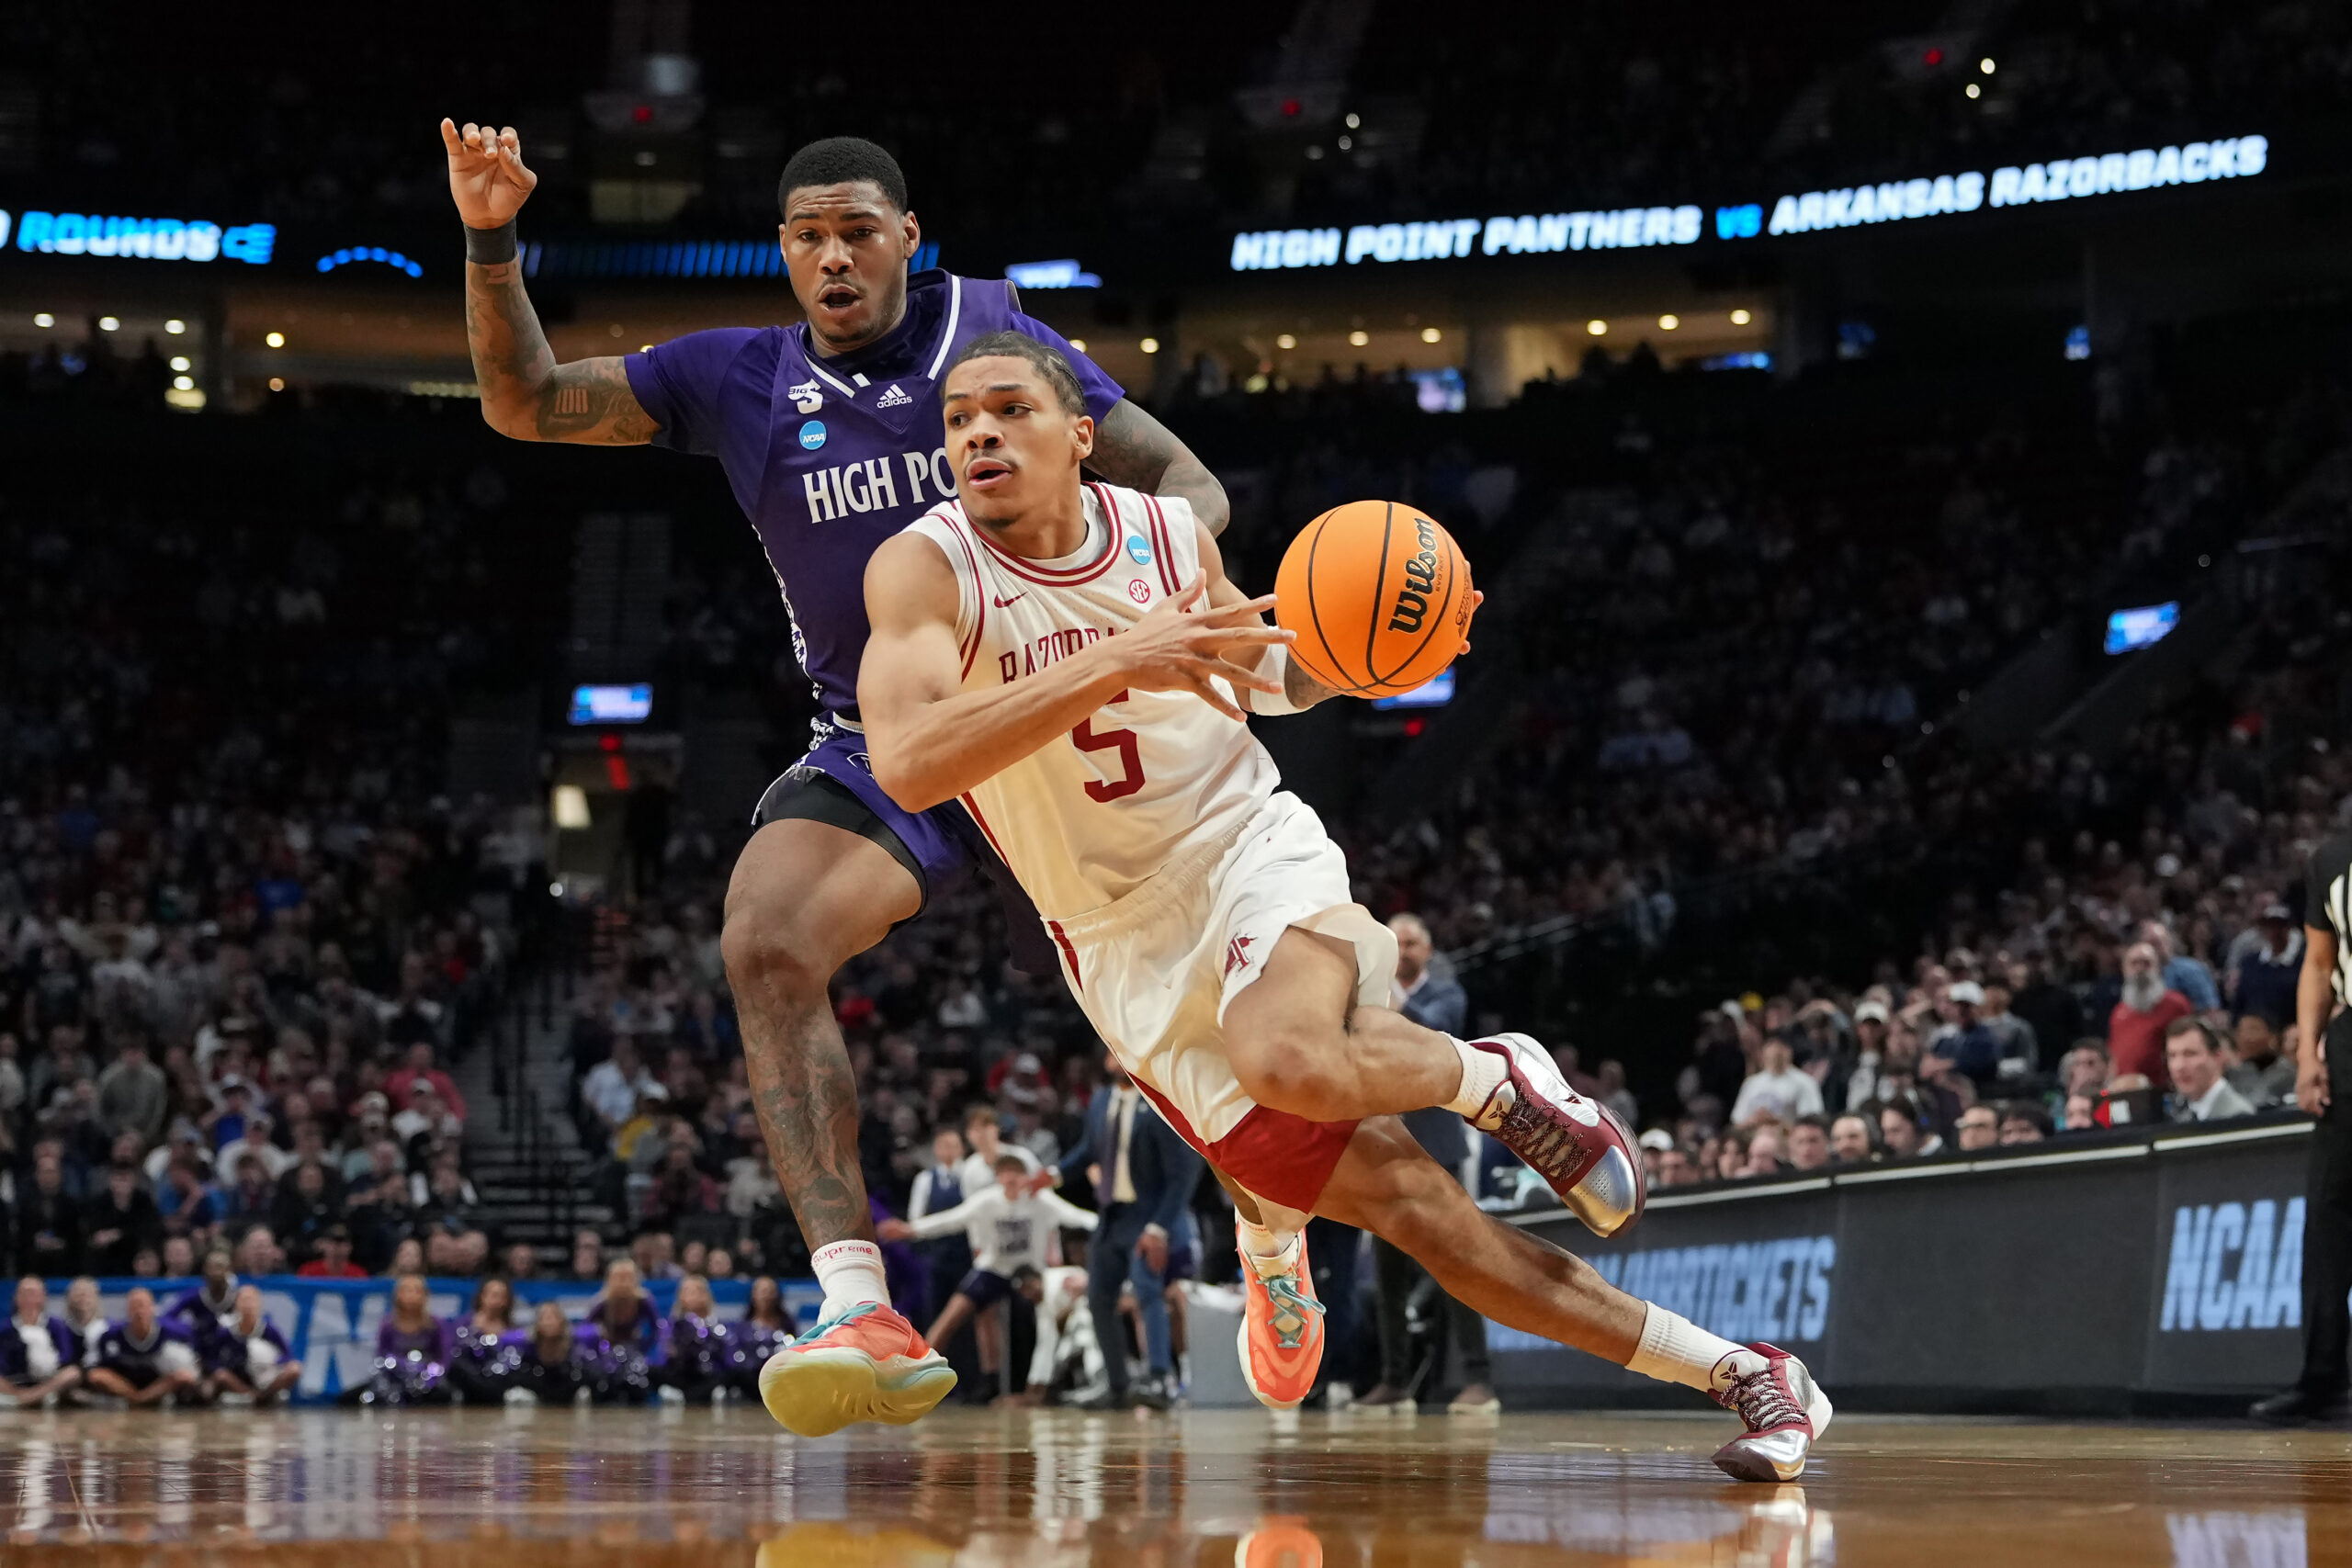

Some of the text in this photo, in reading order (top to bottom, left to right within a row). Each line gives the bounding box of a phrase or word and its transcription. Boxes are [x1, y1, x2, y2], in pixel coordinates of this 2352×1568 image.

[1231, 134, 2268, 271] HIGH POINT PANTHERS VS ARKANSAS RAZORBACKS
[17, 210, 221, 261] ROUNDS
[876, 395, 913, 409] adidas
[802, 433, 825, 444] NCAA
[802, 447, 959, 524] HIGH PO
[1132, 548, 1151, 558] NCAA
[1387, 517, 1437, 635] Wilson
[1130, 581, 1149, 602] SEC
[1072, 687, 1146, 804] 5
[2160, 1195, 2307, 1331] NCAA
